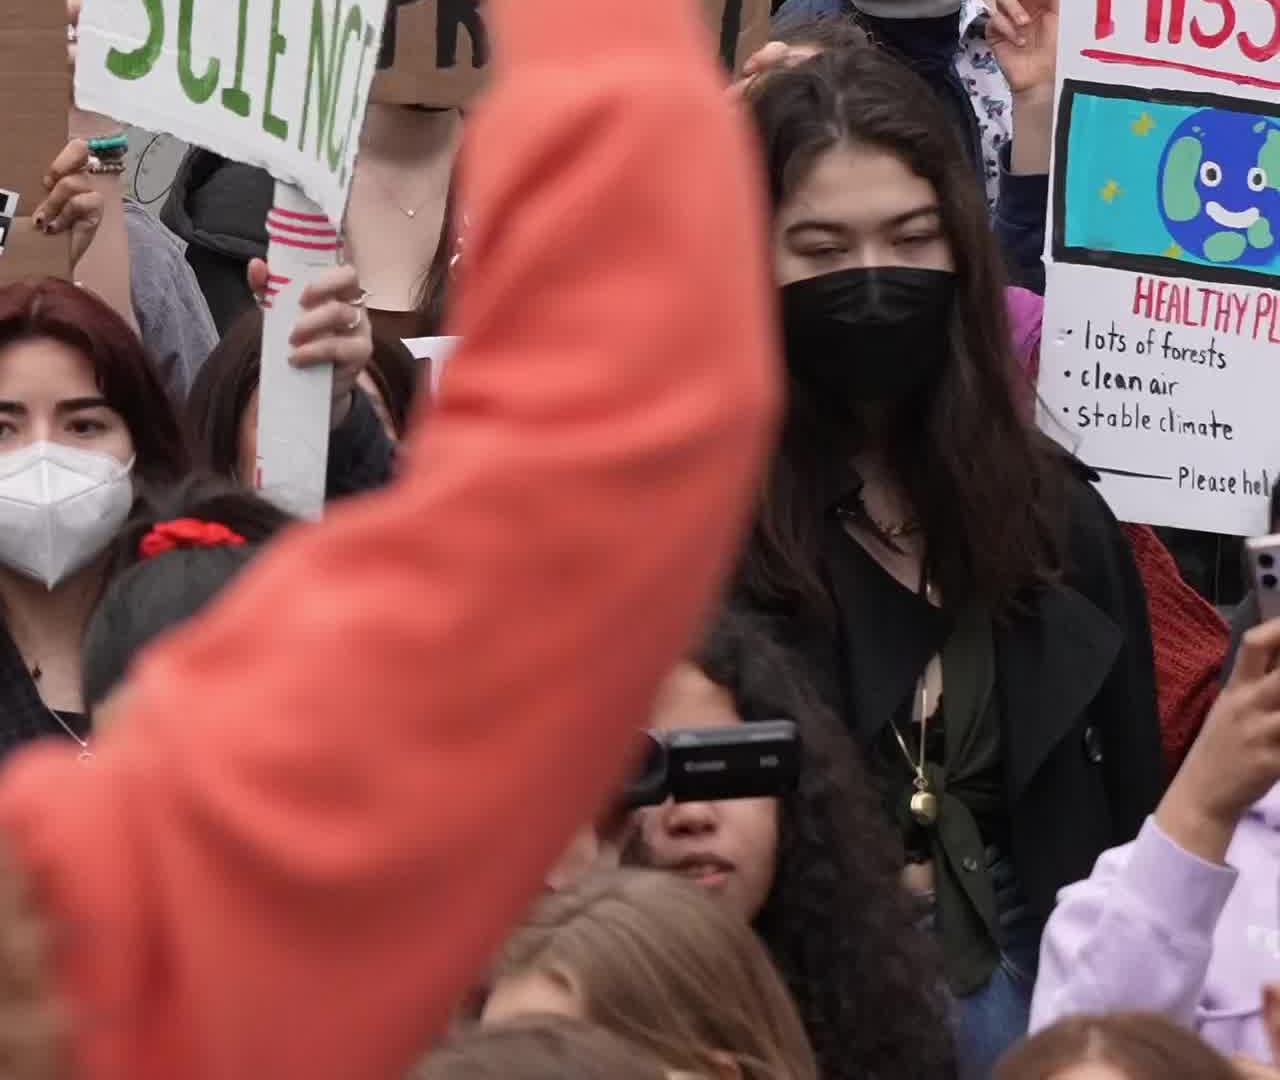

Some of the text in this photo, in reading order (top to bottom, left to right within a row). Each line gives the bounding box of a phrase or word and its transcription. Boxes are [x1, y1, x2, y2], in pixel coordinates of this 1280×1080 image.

[1132, 276, 1249, 335] HEALTHY
[1085, 320, 1226, 369] lots of forests
[1081, 361, 1180, 396] clean air
[1159, 407, 1233, 440] climate
[1179, 466, 1271, 497] Please hel
